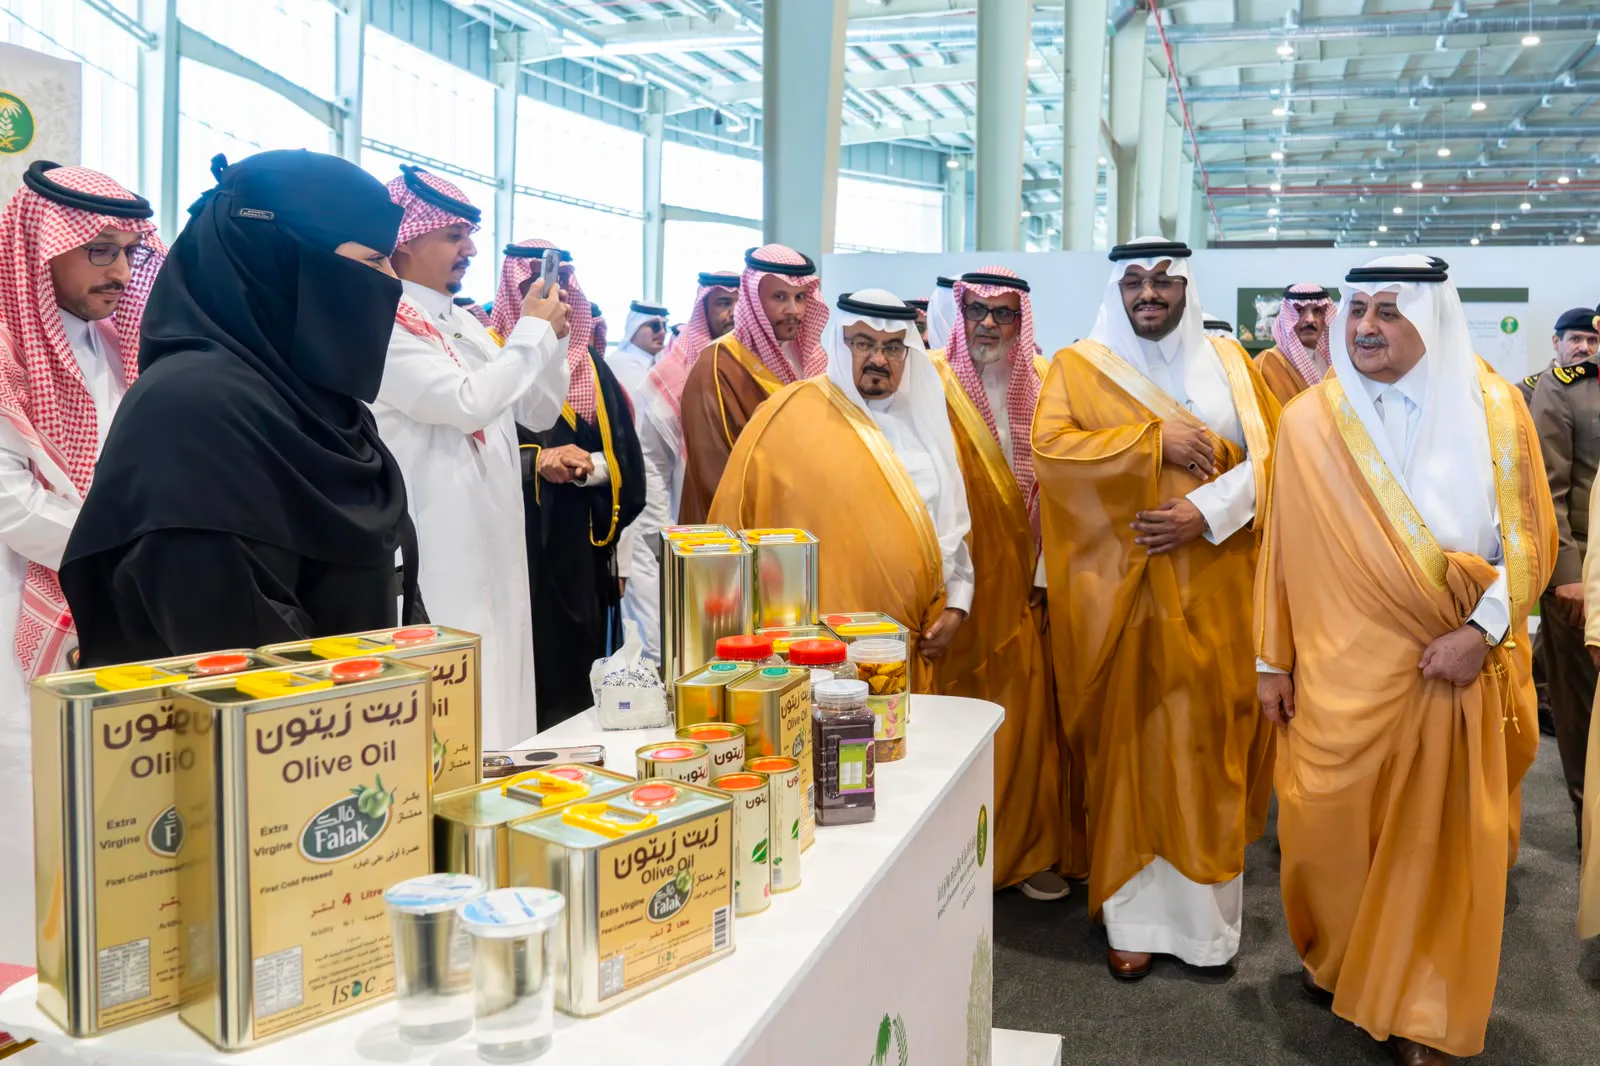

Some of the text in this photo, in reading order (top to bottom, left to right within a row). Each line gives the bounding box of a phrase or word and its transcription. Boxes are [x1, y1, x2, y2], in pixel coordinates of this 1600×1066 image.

[432, 697, 448, 717] il
[256, 690, 418, 755] زيت زيتون
[130, 751, 177, 779] Oli
[282, 739, 397, 784] Olive Oil
[106, 817, 137, 830] Extra
[260, 823, 289, 837] Extra
[682, 817, 719, 850] زيت
[99, 834, 141, 850] Virgine
[314, 821, 370, 853] Falak
[253, 841, 293, 857] Virgine
[614, 830, 677, 880] زيتون
[641, 853, 695, 885] Olive Oil
[105, 878, 126, 888] First
[127, 871, 148, 882] Cold
[260, 883, 279, 895] First
[280, 878, 300, 889] Cold
[342, 892, 352, 906] 4
[361, 887, 384, 901] Litre
[653, 895, 682, 917] Falak
[600, 898, 645, 919] Extra Virgine
[666, 923, 672, 934] 2
